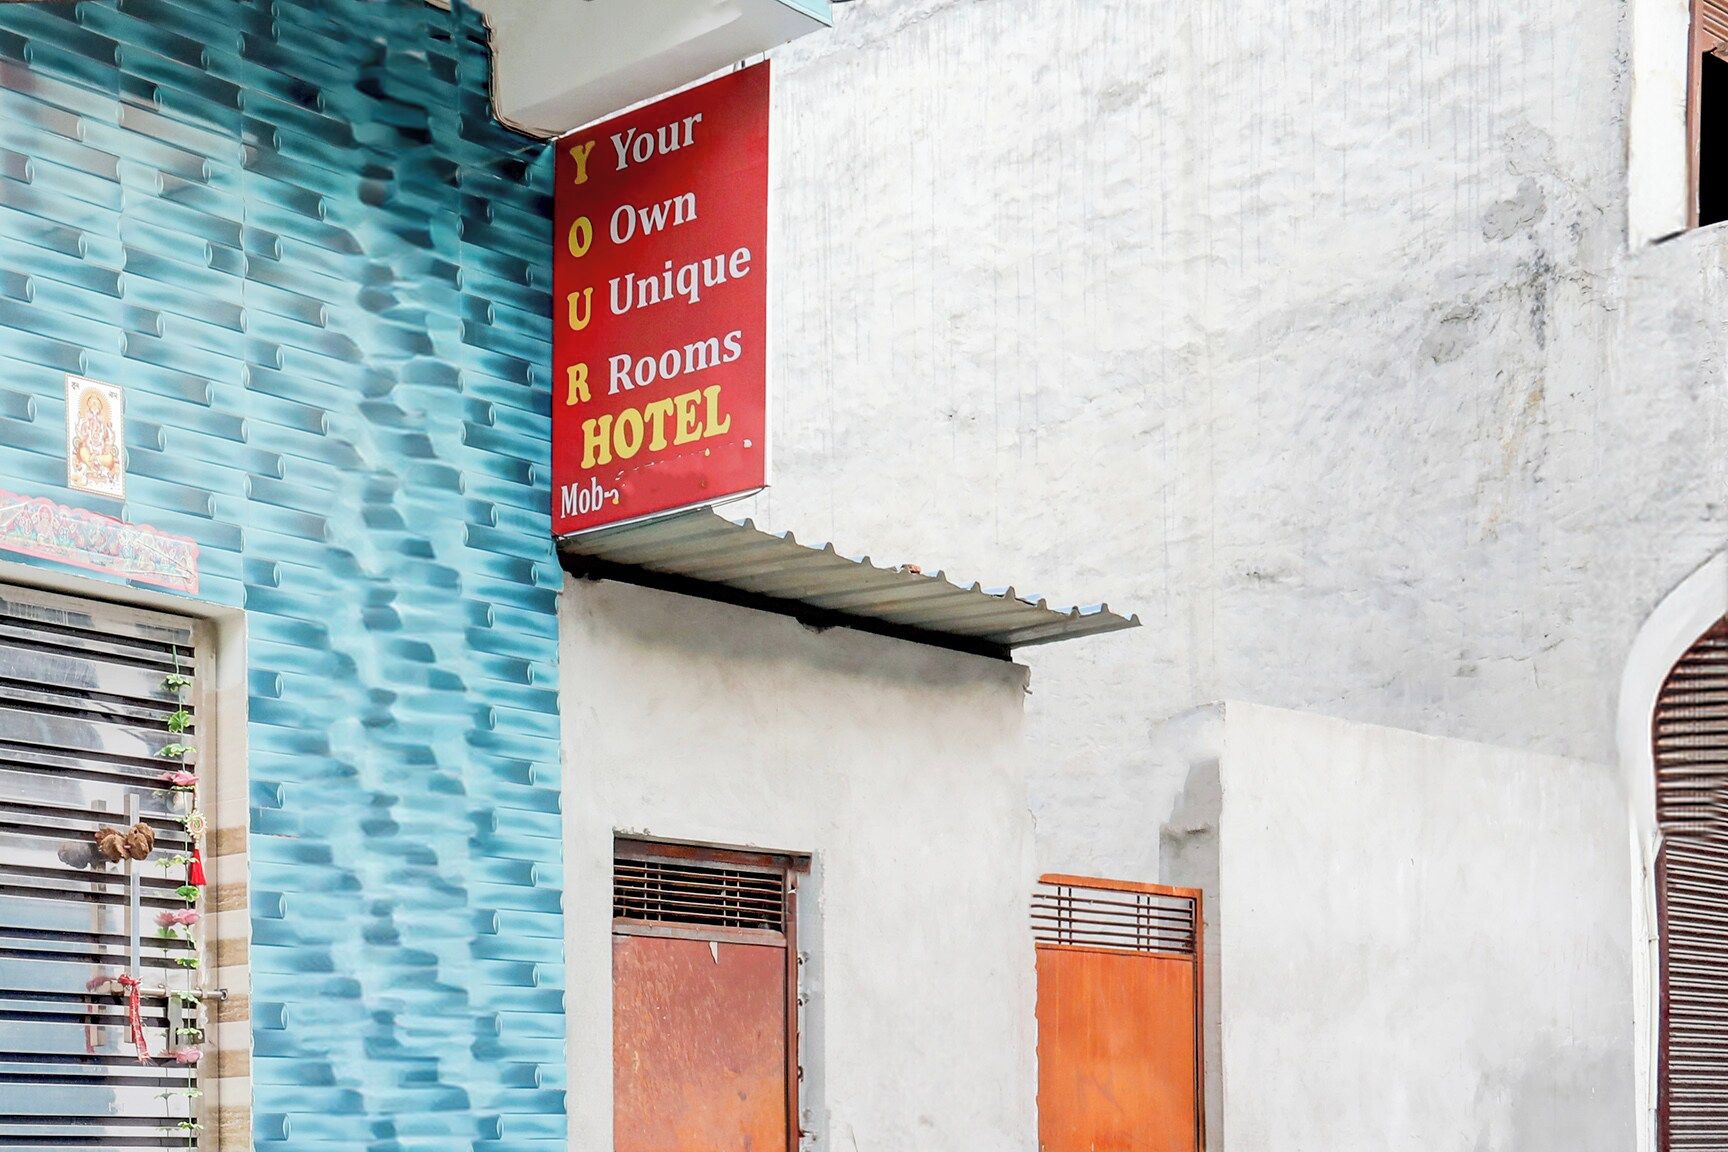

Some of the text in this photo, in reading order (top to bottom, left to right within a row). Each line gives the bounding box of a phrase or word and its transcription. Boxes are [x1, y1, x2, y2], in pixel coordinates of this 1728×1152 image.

[569, 112, 703, 185] Y Your
[568, 190, 698, 258] O Own
[567, 244, 752, 331] U Unique
[566, 329, 742, 406] R Rooms
[580, 384, 731, 470] HOTEL
